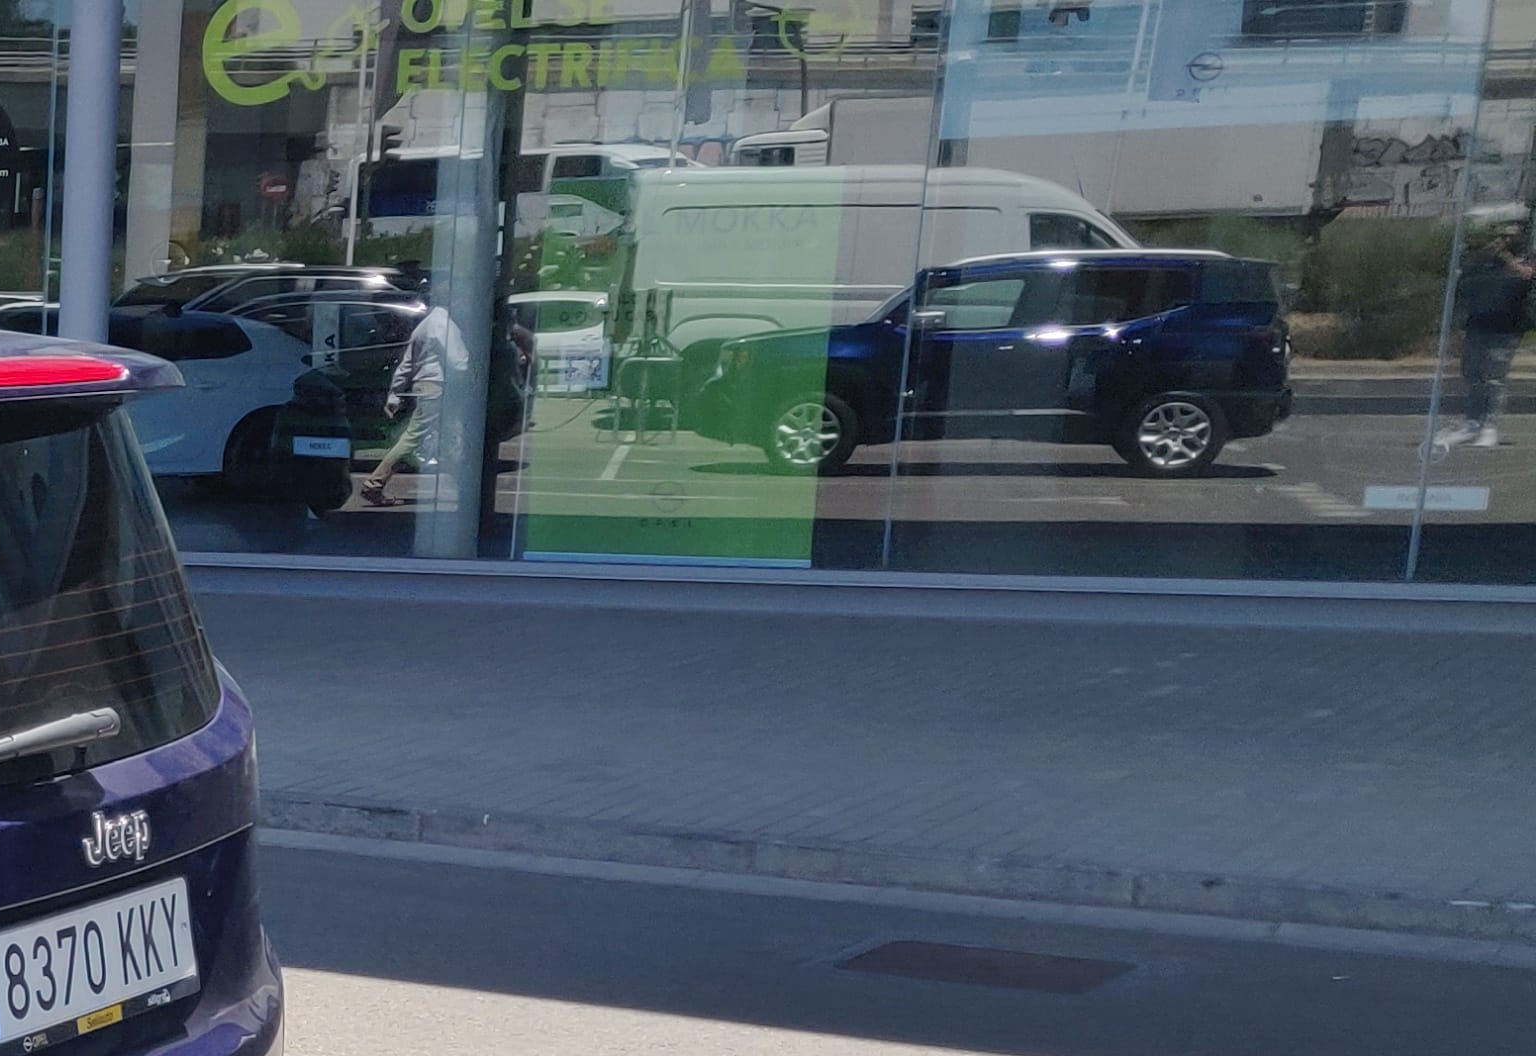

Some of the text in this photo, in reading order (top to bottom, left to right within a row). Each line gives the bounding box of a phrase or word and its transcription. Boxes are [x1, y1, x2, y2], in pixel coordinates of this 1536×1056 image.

[82, 810, 151, 867] Jeep
[4, 892, 179, 1020] 8370 KKY
